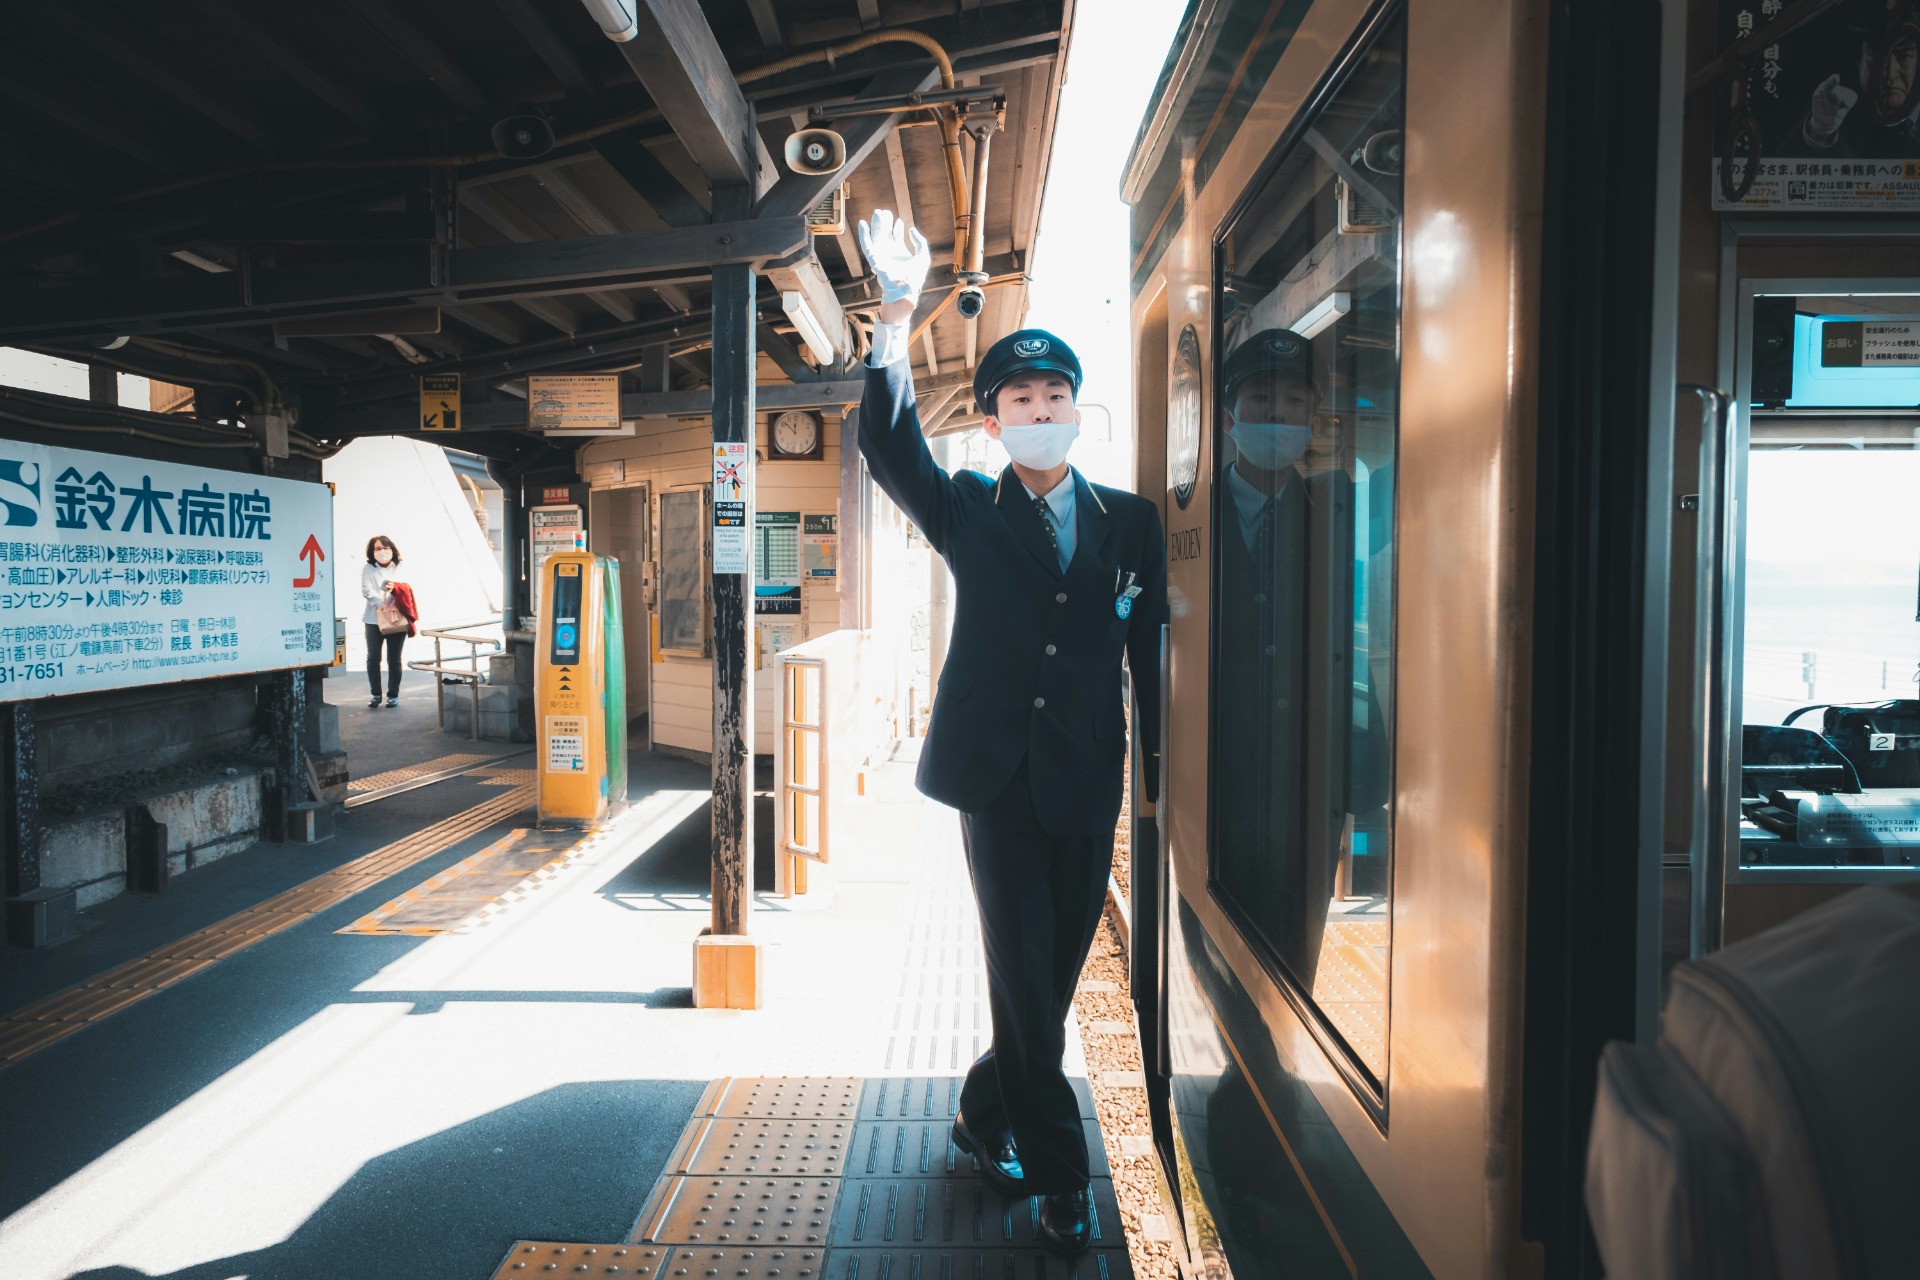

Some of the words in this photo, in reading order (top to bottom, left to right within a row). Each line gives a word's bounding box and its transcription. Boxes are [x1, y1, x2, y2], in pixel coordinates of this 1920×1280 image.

[1826, 337, 1858, 349] お願い
[728, 444, 745, 453] 注意
[55, 466, 271, 541] 鈴木病院
[1170, 526, 1202, 562] ENODEN
[116, 546, 164, 564] 整形外科
[175, 548, 216, 565] 泌尿器科
[225, 550, 263, 566] 呼吸器科
[66, 567, 136, 585] アレルギー科
[146, 568, 181, 585] 小児科
[96, 589, 183, 607] 人間ドック・検診
[171, 635, 192, 651] 院長
[201, 632, 238, 649] 鈴木信吾
[76, 659, 129, 675] ホームページ
[132, 650, 238, 671] http://www.suzuki-hp.ne.jp
[1876, 736, 1889, 749] 2
